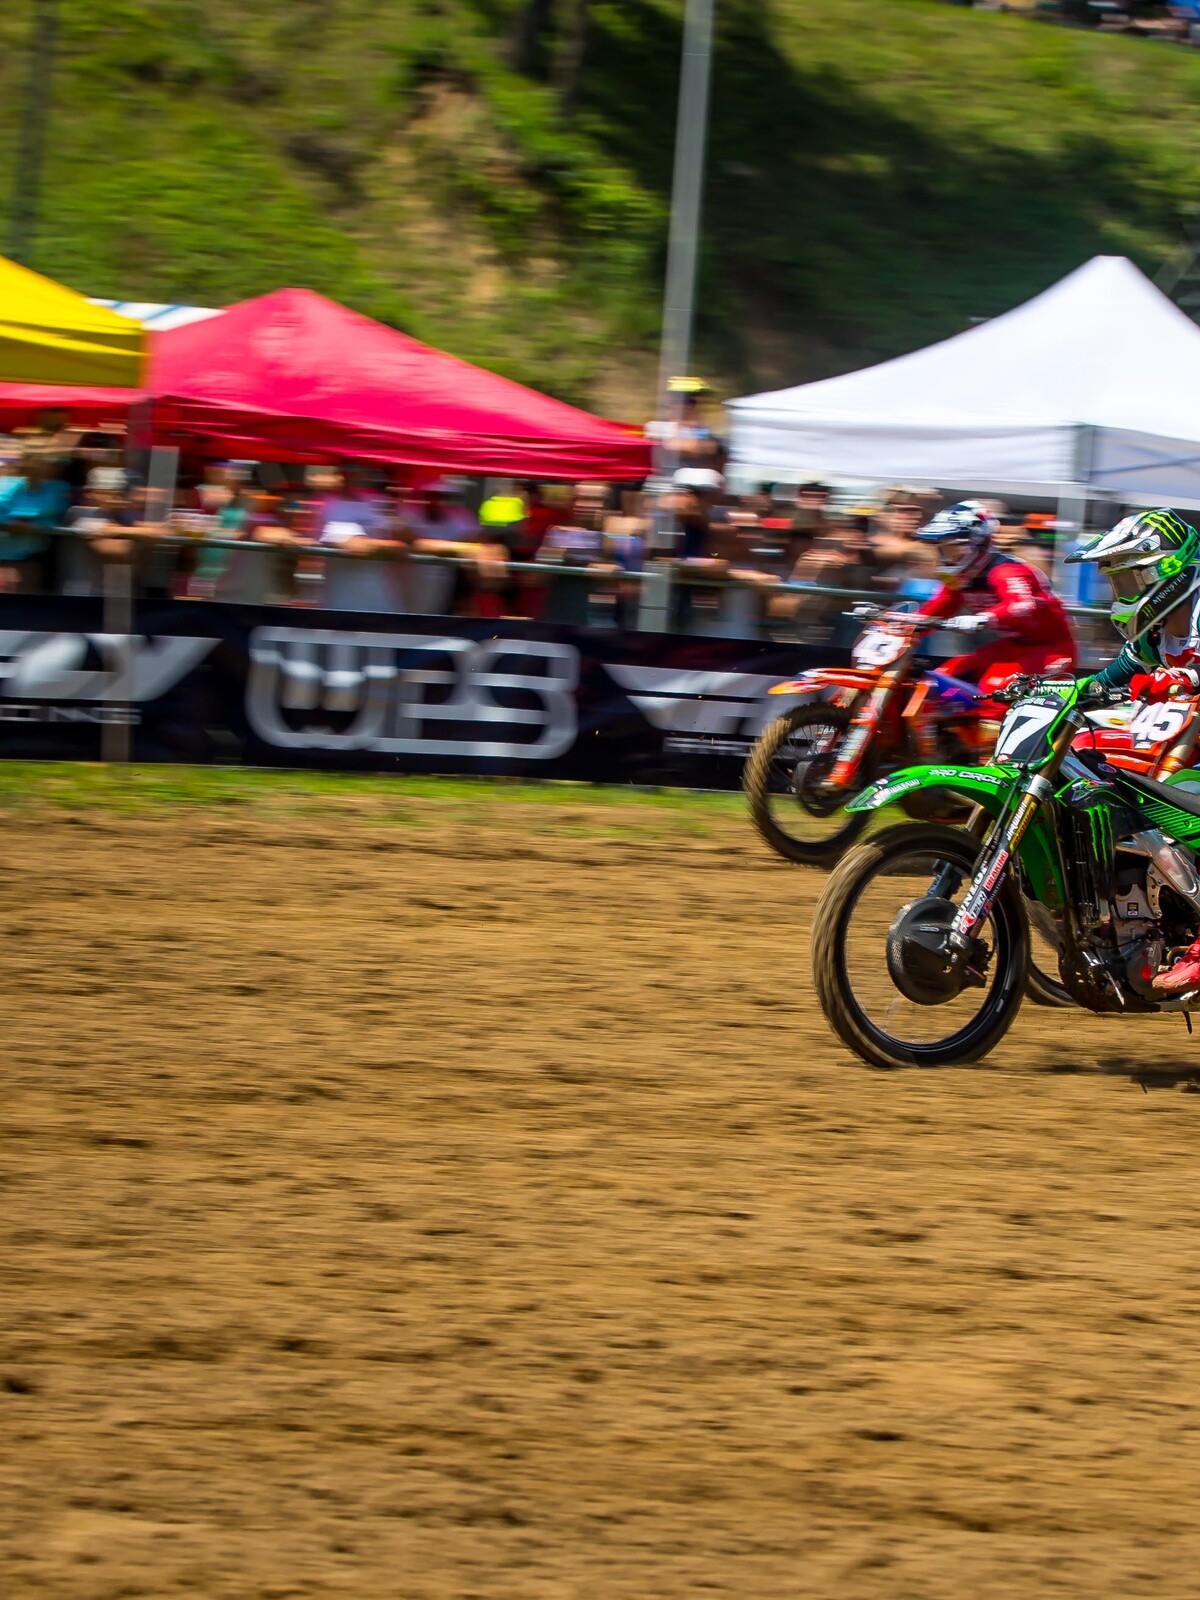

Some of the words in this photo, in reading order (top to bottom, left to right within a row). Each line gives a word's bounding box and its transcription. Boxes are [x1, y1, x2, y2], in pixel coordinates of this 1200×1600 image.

[1152, 571, 1188, 606] MONSTER
[995, 704, 1062, 758] 17
[1130, 701, 1191, 743] 45
[984, 850, 1009, 892] BRAKING
[950, 864, 988, 930] DUNLOP
